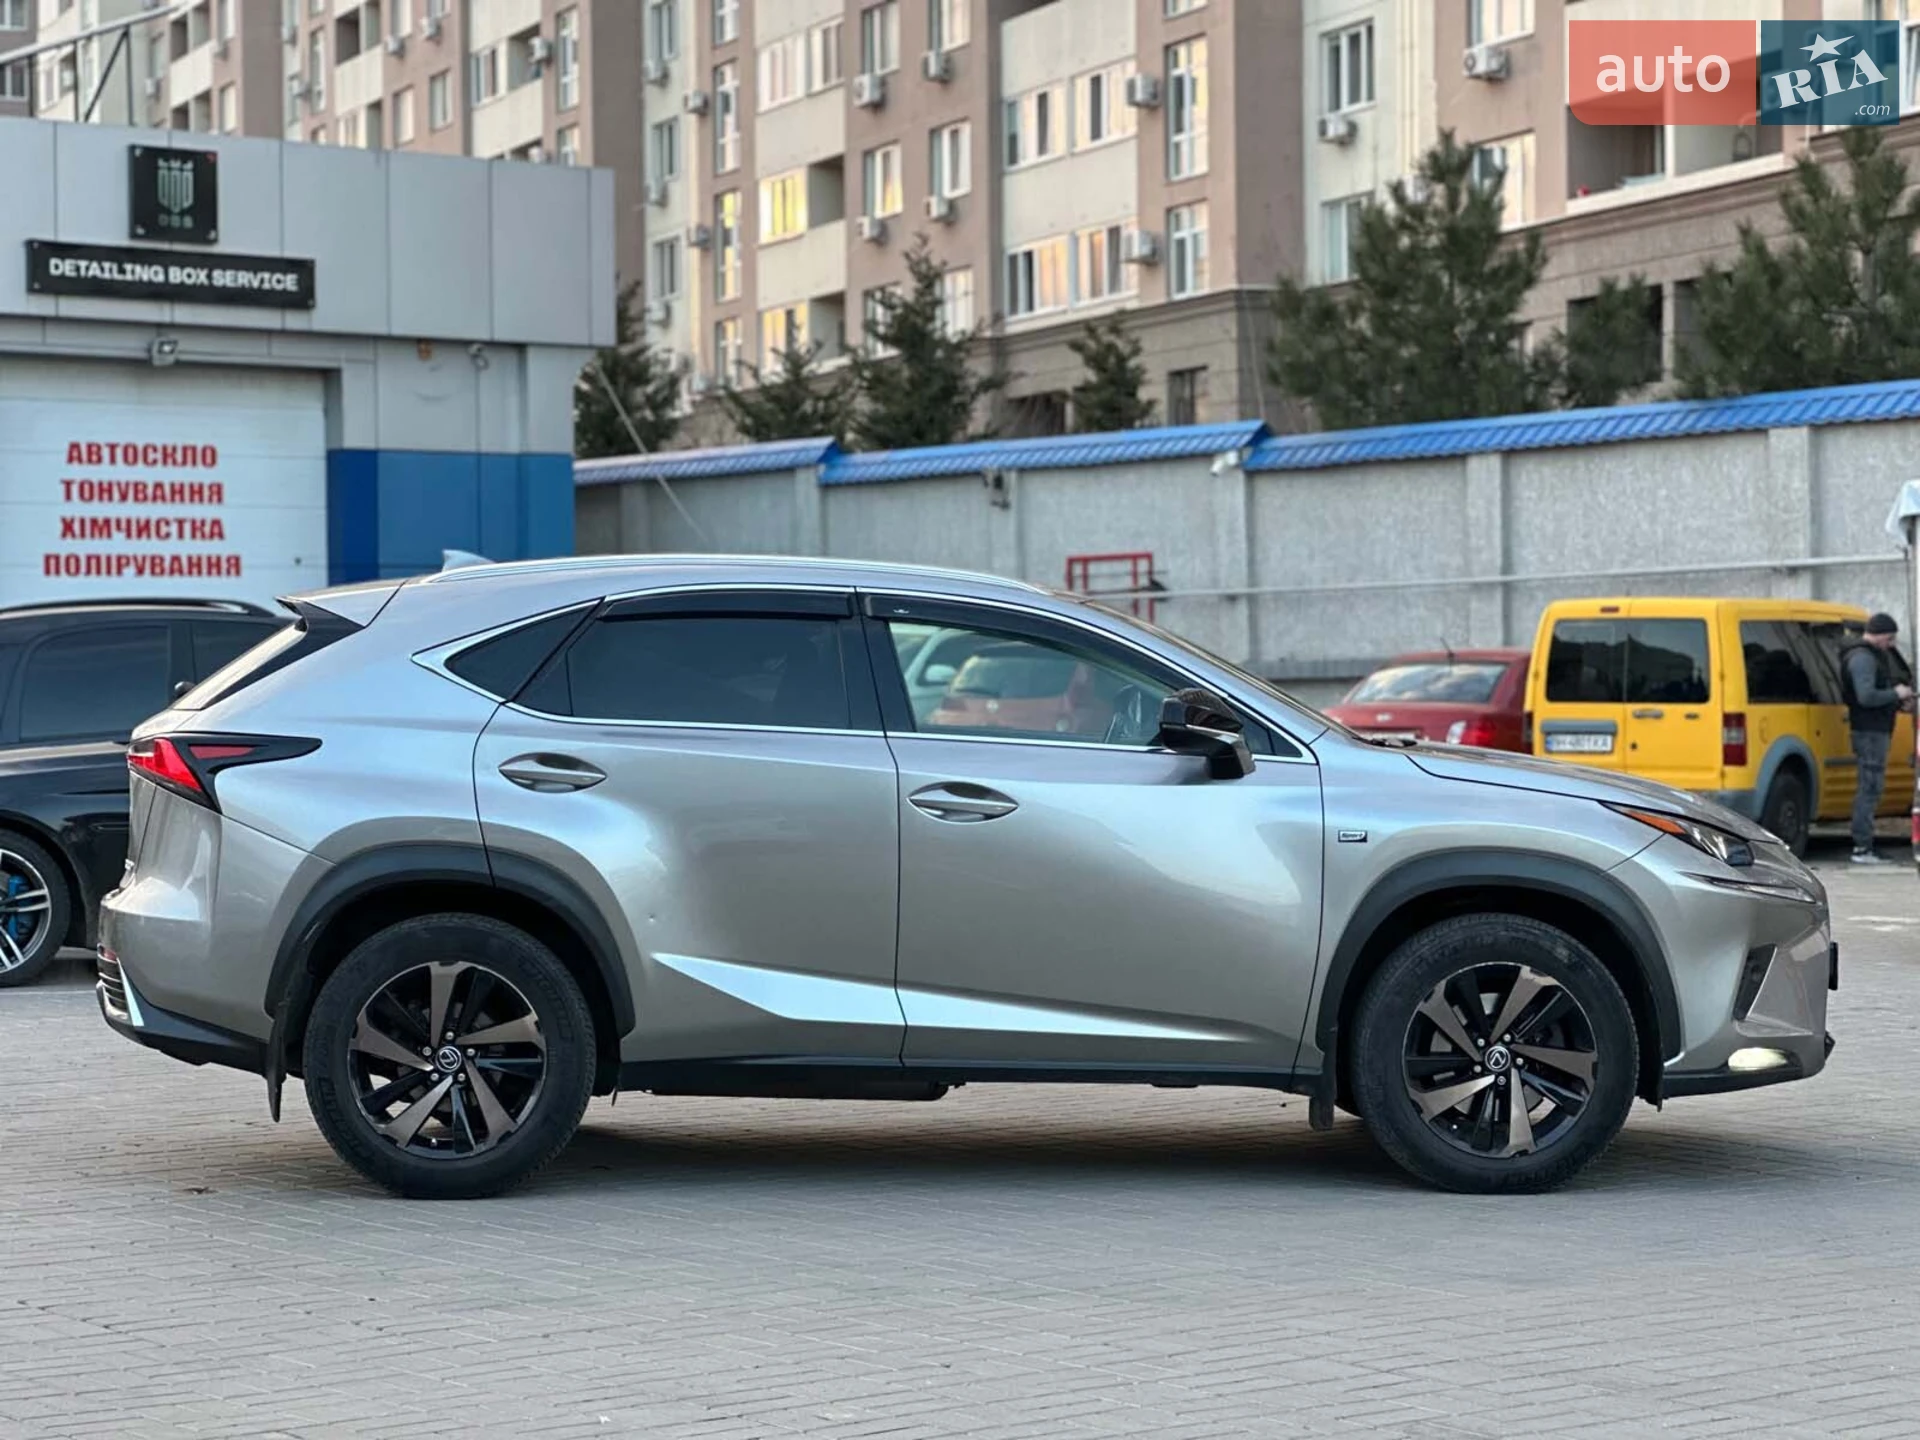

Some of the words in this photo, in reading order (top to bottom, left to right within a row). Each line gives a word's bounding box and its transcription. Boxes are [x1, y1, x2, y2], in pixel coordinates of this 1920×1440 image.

[49, 257, 165, 283] DETAILING
[168, 265, 209, 286] BOX
[211, 268, 299, 291] SERVICE
[66, 441, 218, 468] АВТОСКЛО
[60, 479, 224, 505] ТОНУВАННЯ
[60, 516, 226, 541] ХІМЧИСТКА
[43, 553, 242, 577] ПОЛІРУВАННЯ
